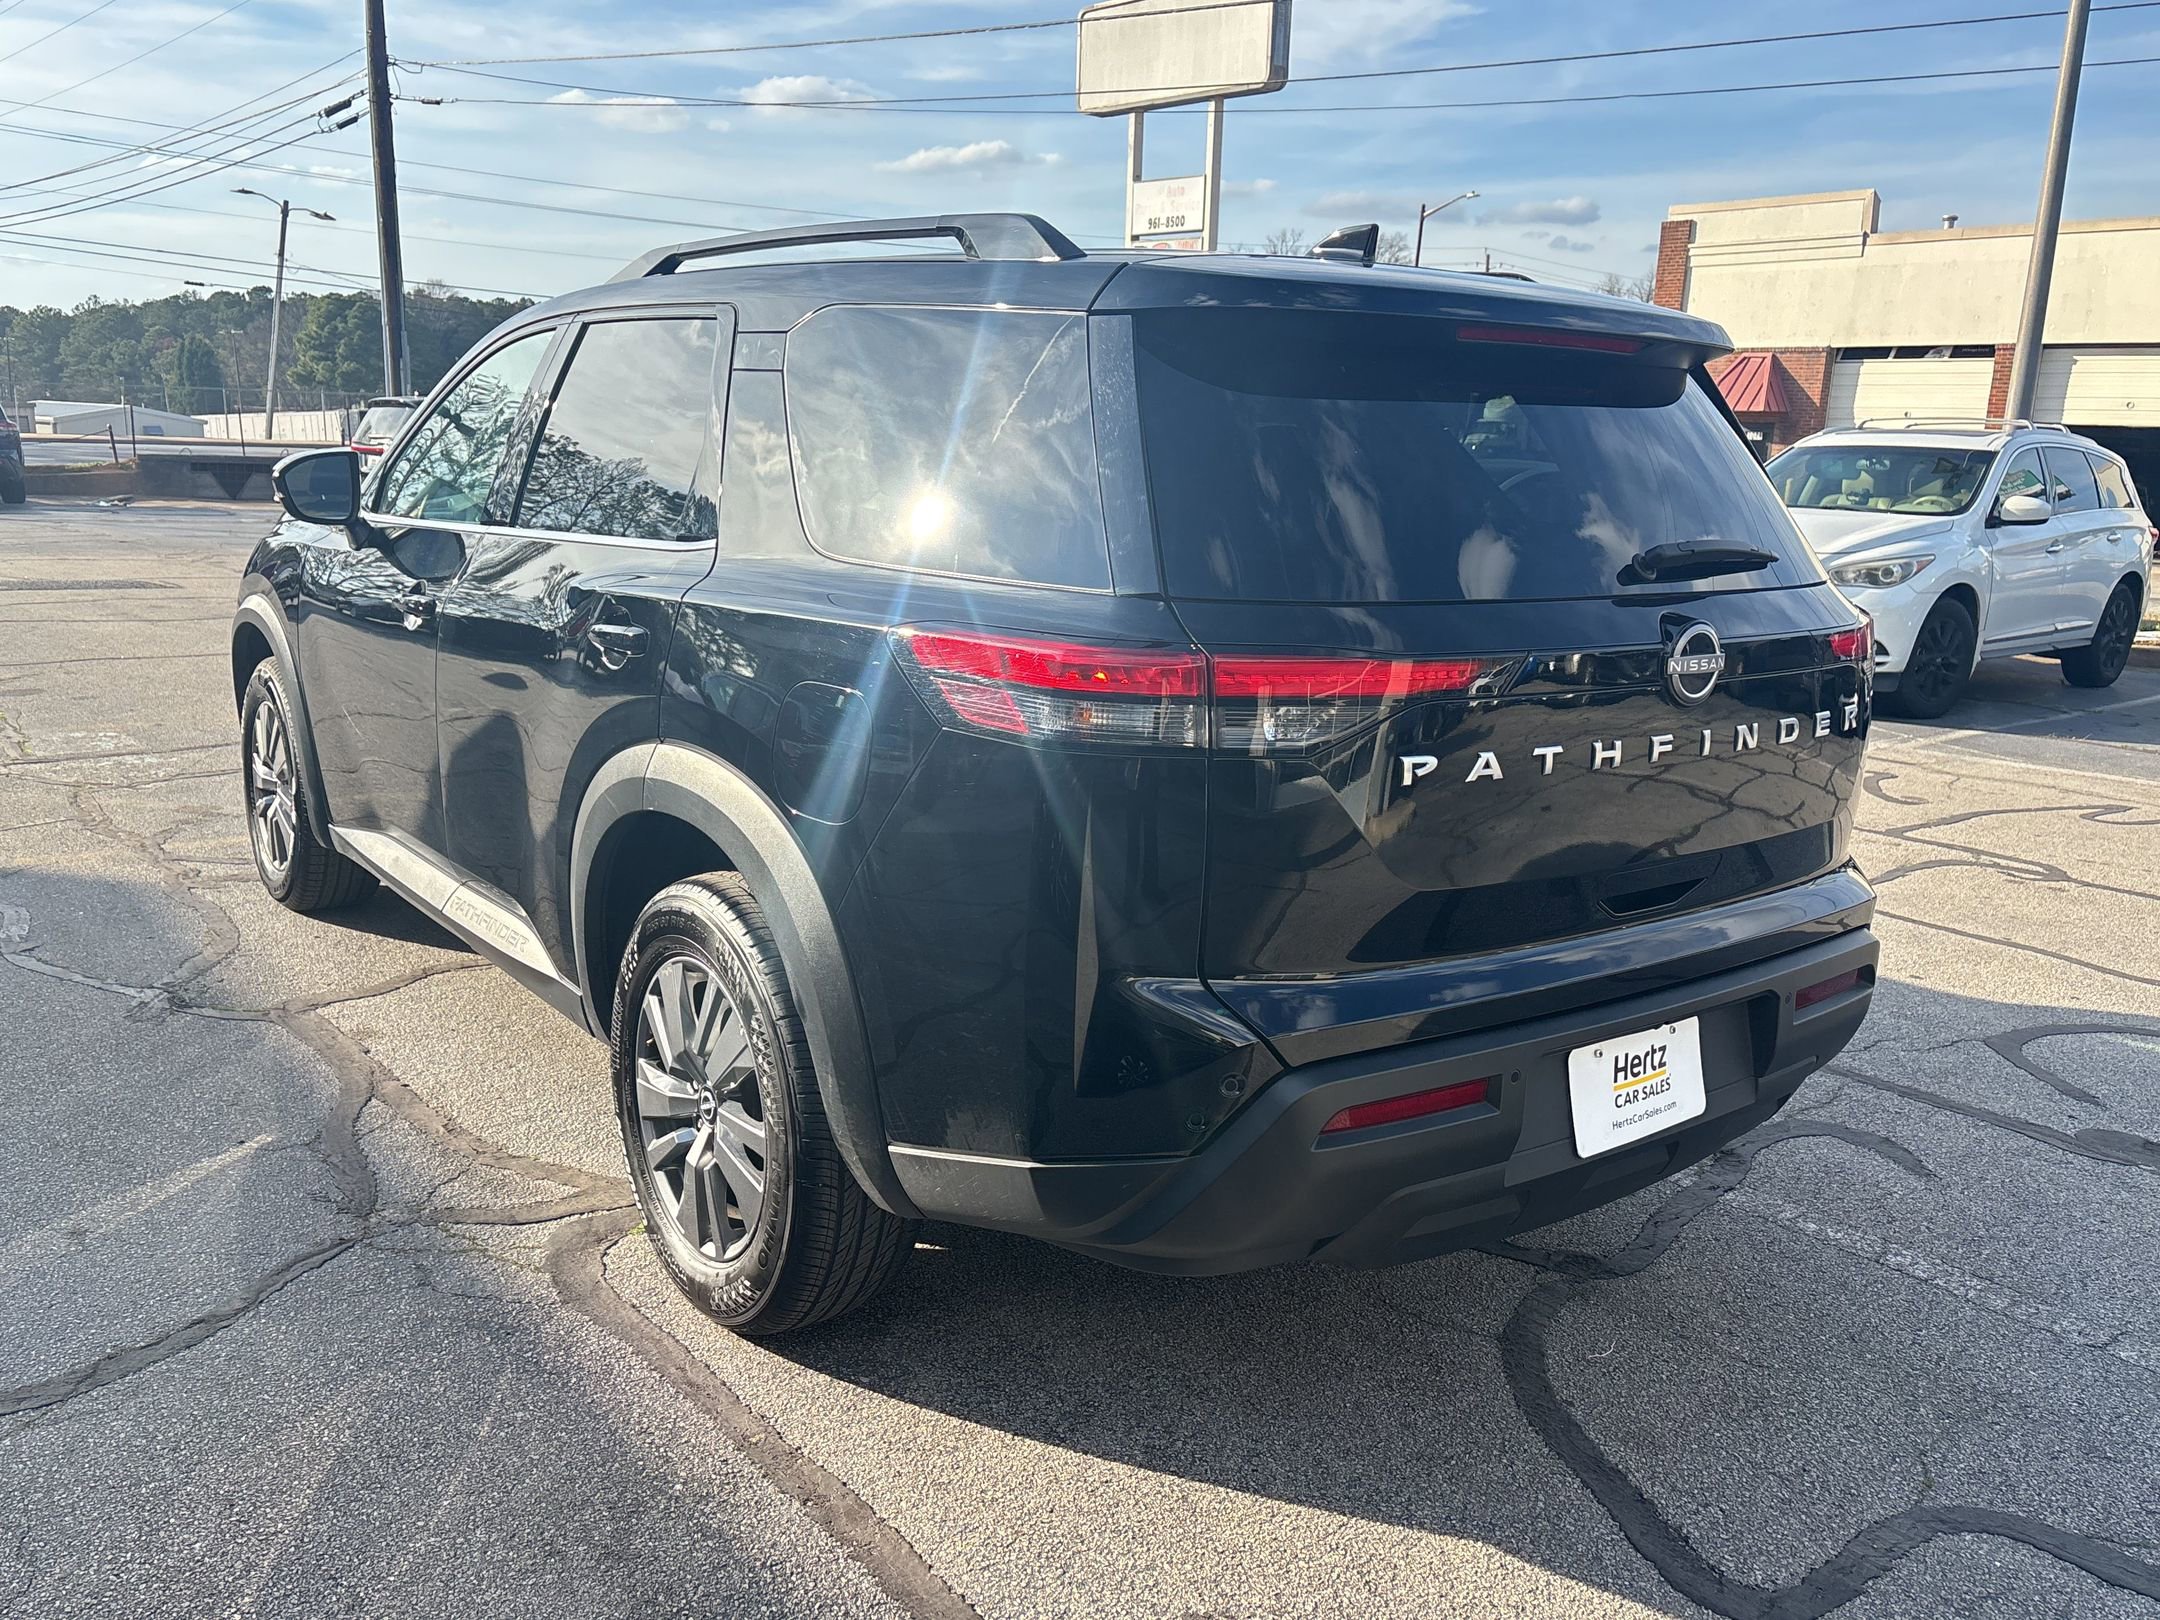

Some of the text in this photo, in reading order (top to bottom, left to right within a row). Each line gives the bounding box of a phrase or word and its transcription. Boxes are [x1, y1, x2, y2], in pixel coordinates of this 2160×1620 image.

[1148, 215, 1186, 230] 961-8500
[1669, 657, 1725, 673] NISSAN
[1400, 704, 1858, 786] PATHFINDER
[450, 895, 530, 953] PATHFINDER
[1613, 1044, 1667, 1083] Hertz
[1614, 1077, 1671, 1109] CAR SALES
[1612, 1101, 1677, 1131] HertzCarSales.com
